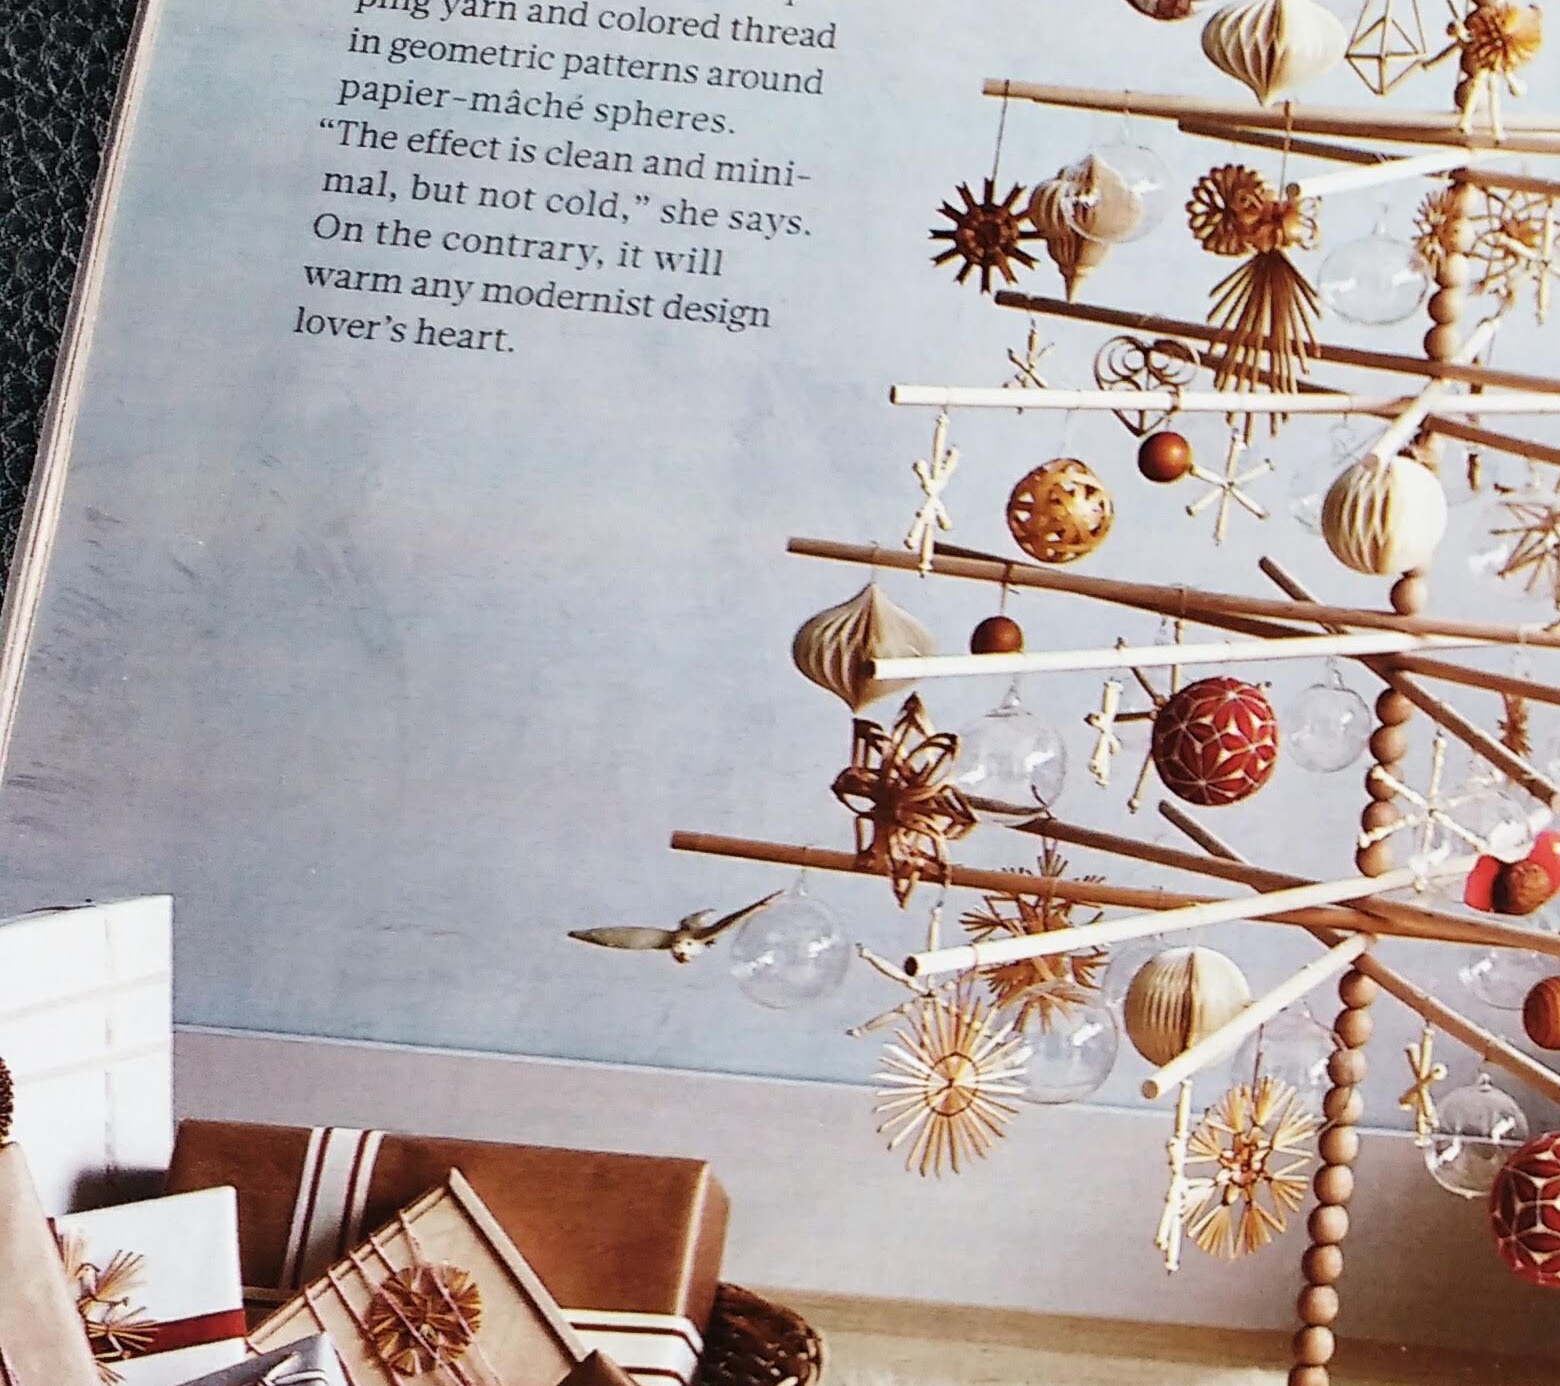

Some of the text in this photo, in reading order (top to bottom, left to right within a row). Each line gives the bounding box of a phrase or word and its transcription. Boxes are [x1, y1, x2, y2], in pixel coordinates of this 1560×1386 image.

[524, 0, 590, 29] and
[596, 4, 722, 42] colored
[729, 14, 838, 51] thread
[346, 25, 825, 97] in geometric patterns around
[334, 77, 737, 136] papier-mâché spheres.
[318, 116, 813, 189] “The effect is clean and mini-
[320, 168, 812, 242] mal, but not cold,” she says.
[311, 211, 724, 278] On the contrary, it will
[291, 304, 516, 354] lover’s heart.
[302, 264, 773, 334] warm any modernist design
